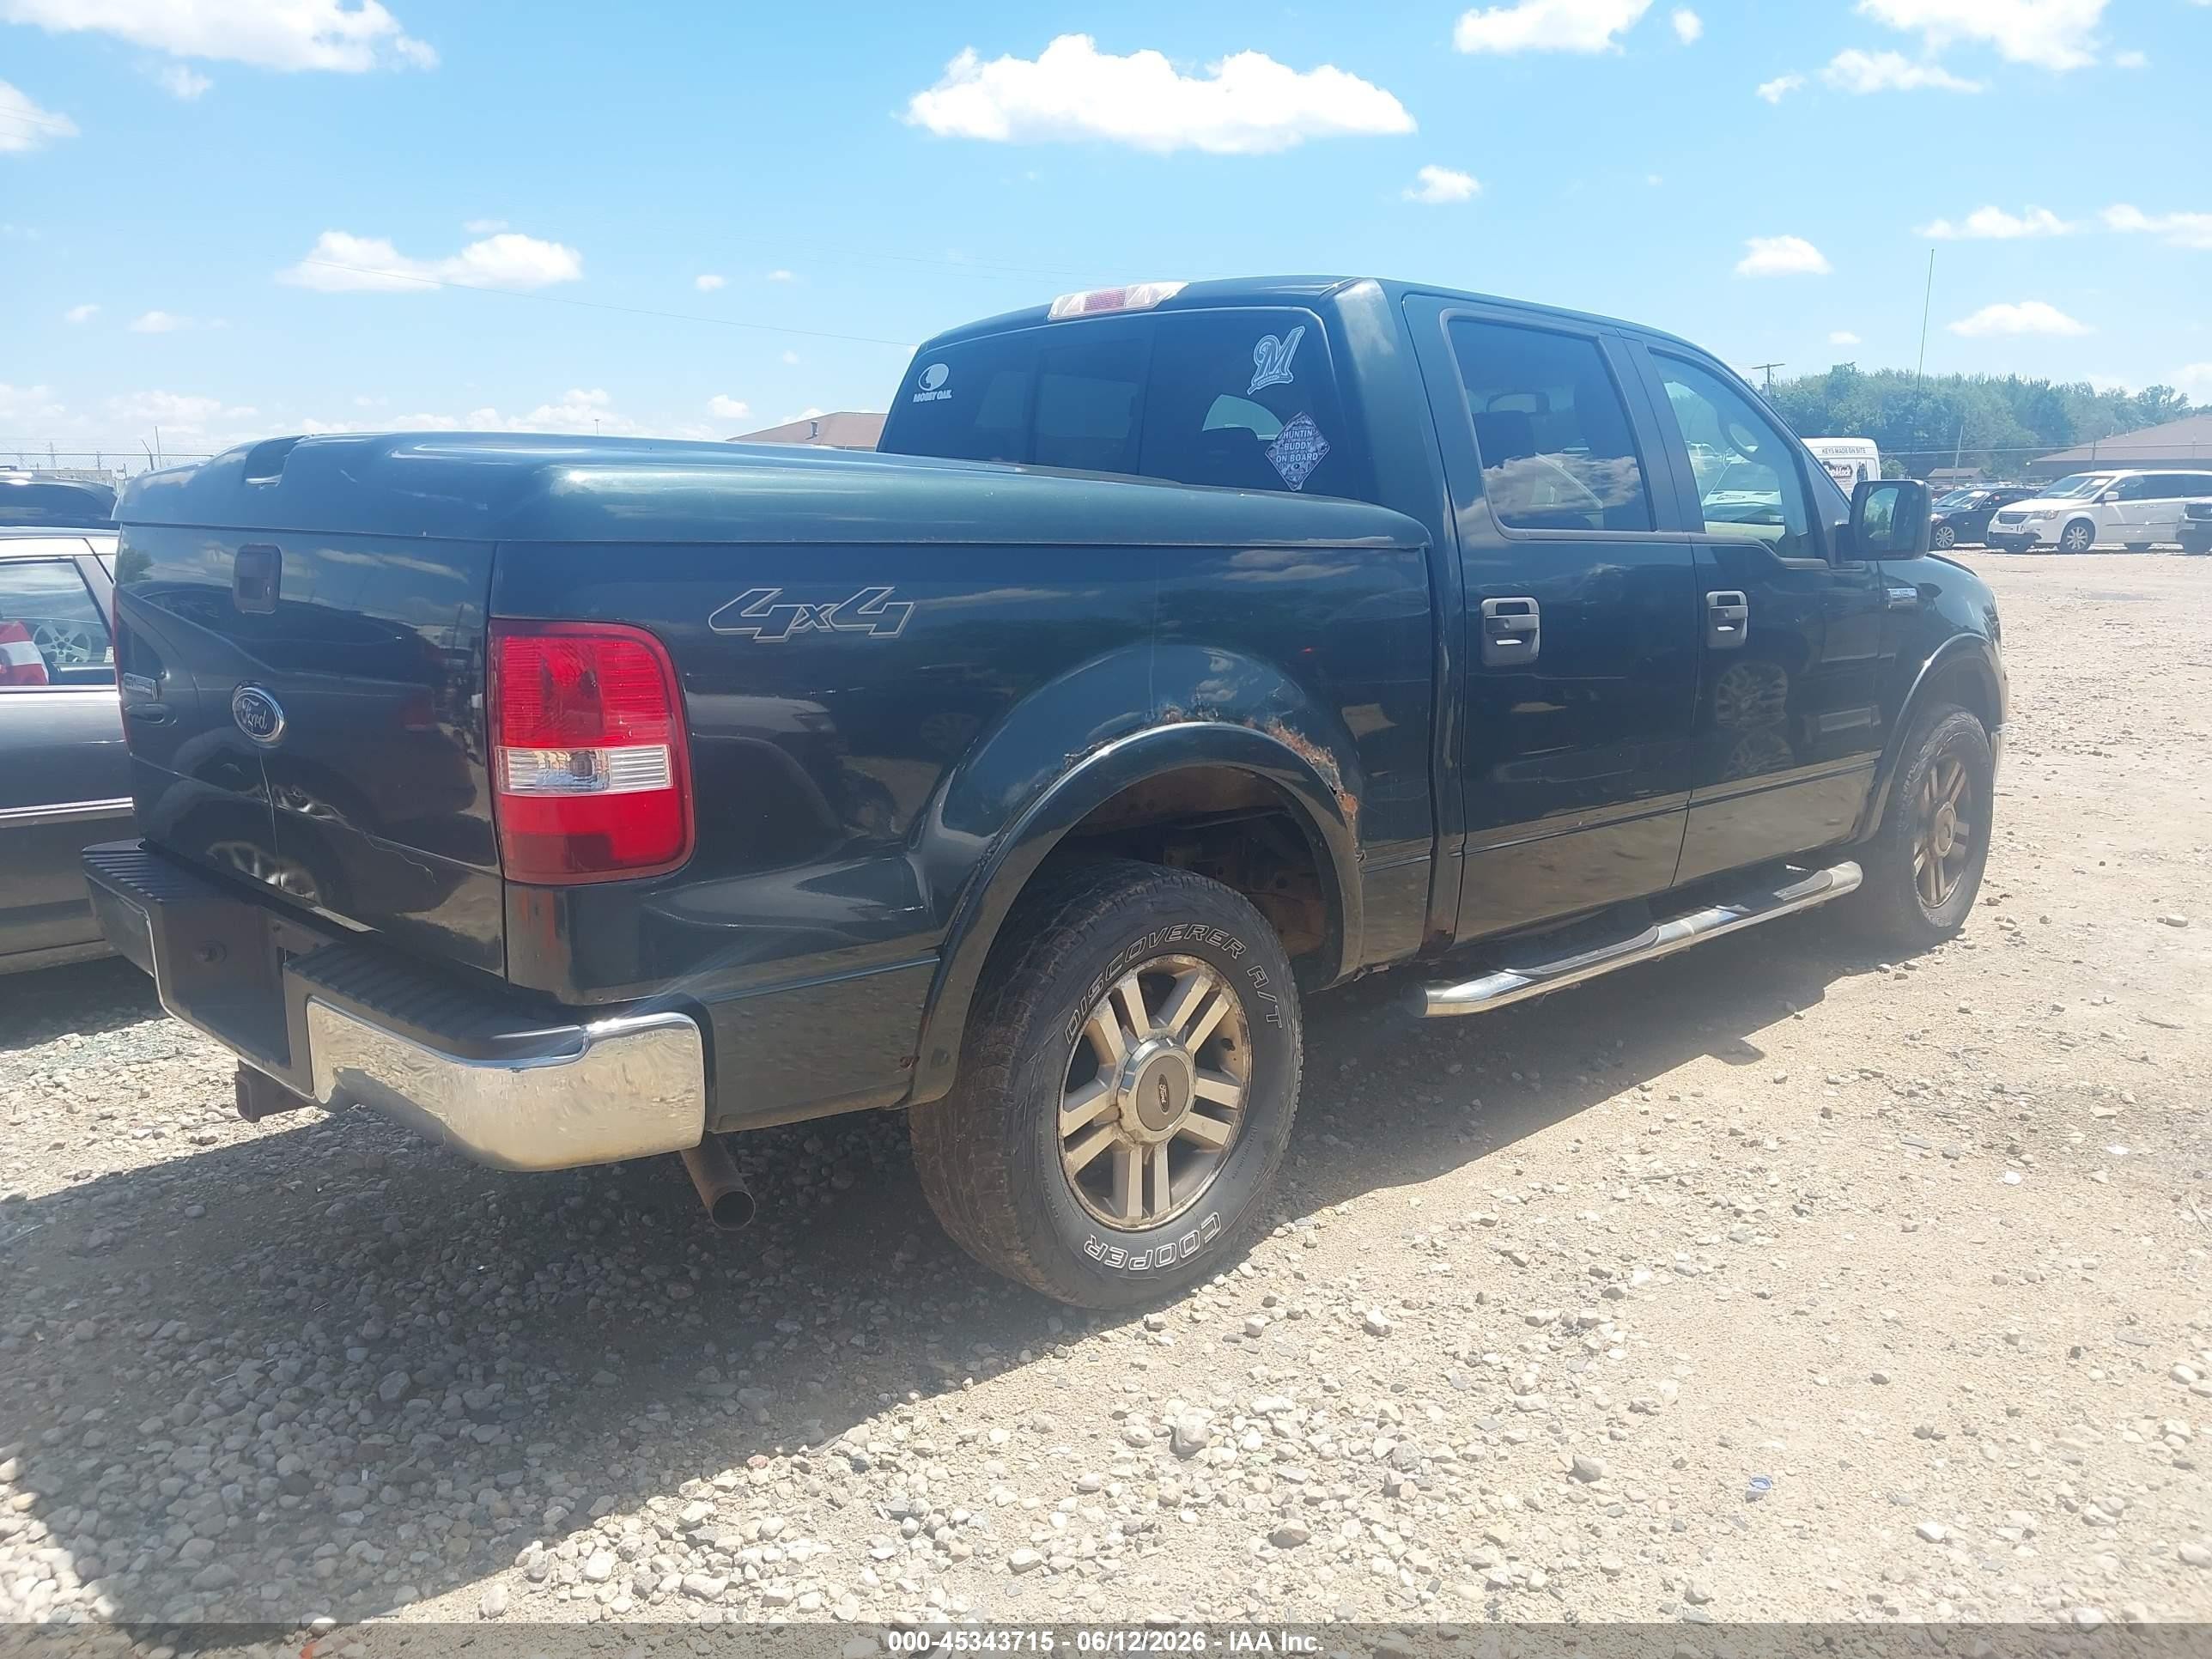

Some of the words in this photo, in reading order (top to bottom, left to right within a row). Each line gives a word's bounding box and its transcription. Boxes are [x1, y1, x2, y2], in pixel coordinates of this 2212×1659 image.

[1284, 441, 1312, 451] BUDDY
[1290, 453, 1318, 462] BOARD
[240, 696, 269, 732] Ford
[1064, 922, 1246, 1045] DISCOVERER
[1247, 964, 1282, 1029] A/T
[1084, 1212, 1221, 1271] COOPER
